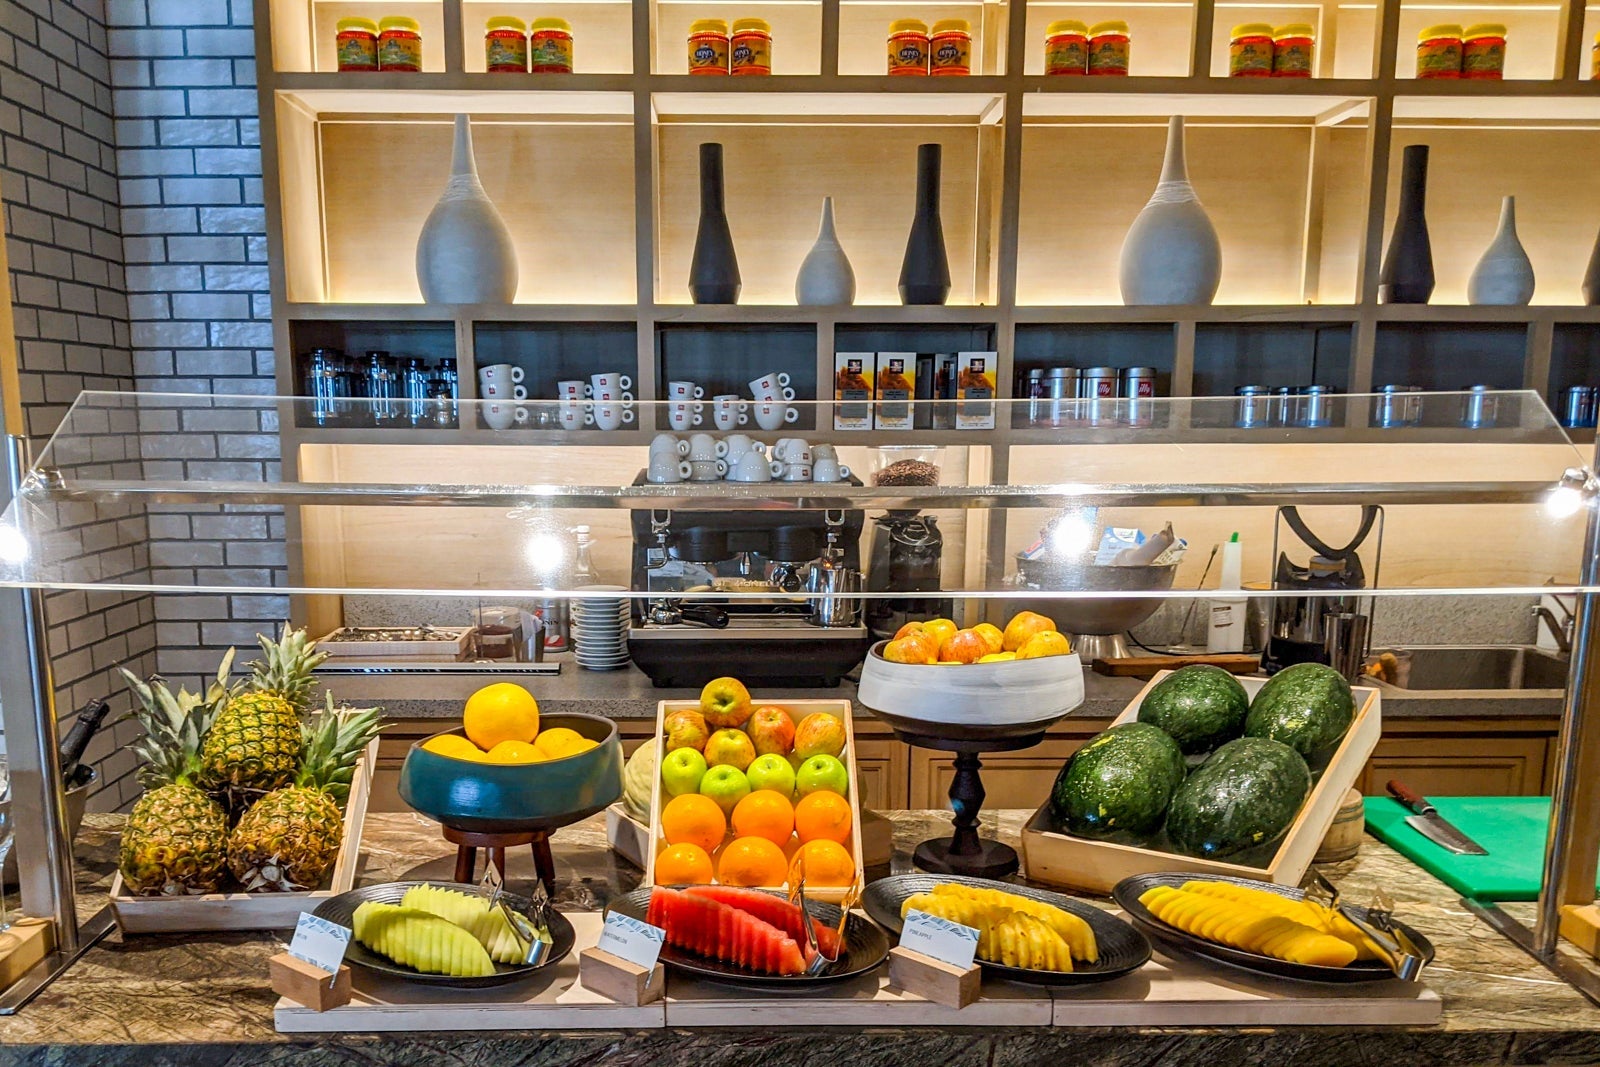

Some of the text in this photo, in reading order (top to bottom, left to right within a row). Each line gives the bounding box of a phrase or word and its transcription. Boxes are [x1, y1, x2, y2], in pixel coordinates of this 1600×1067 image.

[1098, 383, 1111, 395] illy
[1138, 383, 1151, 394] illy
[909, 928, 933, 940] PINEAPPLE
